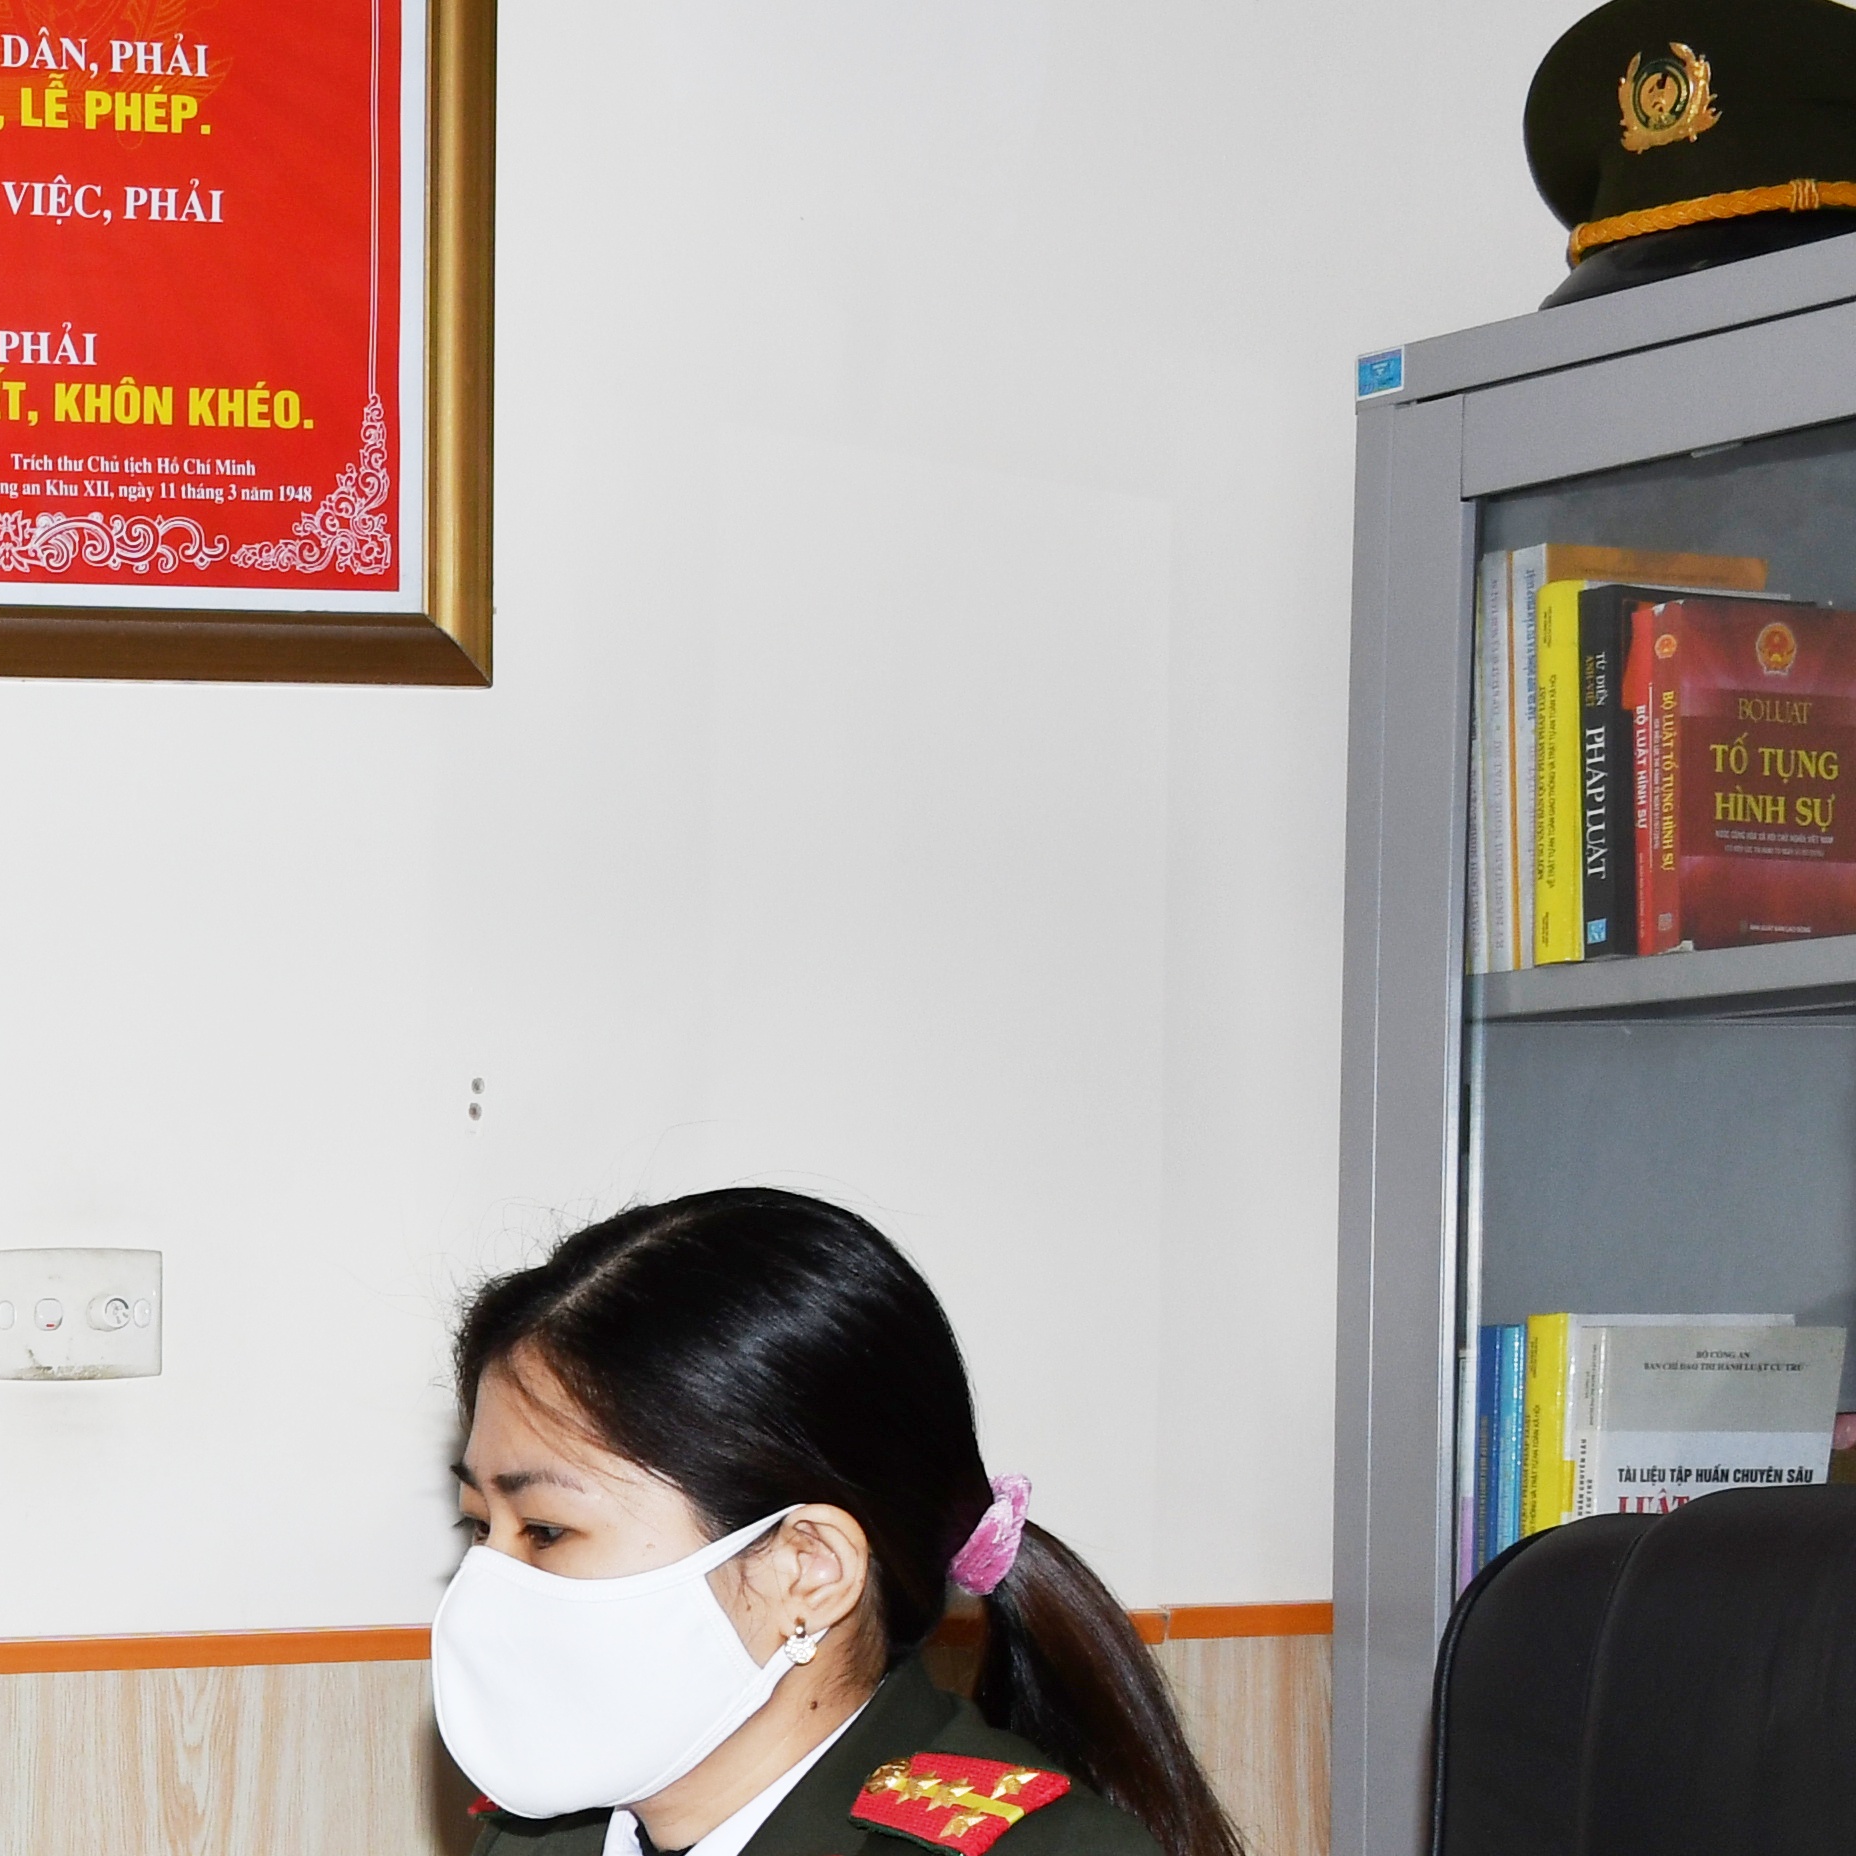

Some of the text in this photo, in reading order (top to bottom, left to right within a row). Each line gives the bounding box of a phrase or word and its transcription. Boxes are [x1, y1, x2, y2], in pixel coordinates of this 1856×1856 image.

[2, 29, 98, 77] DÂN,
[111, 34, 207, 76] PHẢI
[21, 74, 68, 128] LỄ
[86, 82, 210, 134] PHÉP.
[3, 175, 111, 224] VIỆC,
[125, 179, 222, 222] PHẢI
[55, 377, 172, 424] KHÔN
[189, 382, 313, 428] KHÉO.
[11, 454, 255, 475] Trích thư Chủ tịch Hồ Chí Minh
[23, 484, 40, 494] an
[46, 480, 77, 496] Khu
[84, 481, 114, 497] XII,
[119, 486, 152, 501] ngày
[161, 483, 174, 498] 11
[182, 484, 223, 502] tháng
[228, 485, 236, 499] 3
[242, 489, 273, 500] năm
[280, 486, 311, 501] 1948
[1709, 732, 1839, 784] TỐ TỤNG
[1585, 726, 1608, 879] PHÁP LUẬT
[1714, 785, 1836, 833] HÌNH SỰ
[1618, 1465, 1636, 1483] TÀI
[1640, 1465, 1666, 1486] LIỆU
[1669, 1465, 1692, 1486] TẬP
[1695, 1463, 1729, 1483] HUẤN
[1733, 1465, 1783, 1483] CHUYÊN
